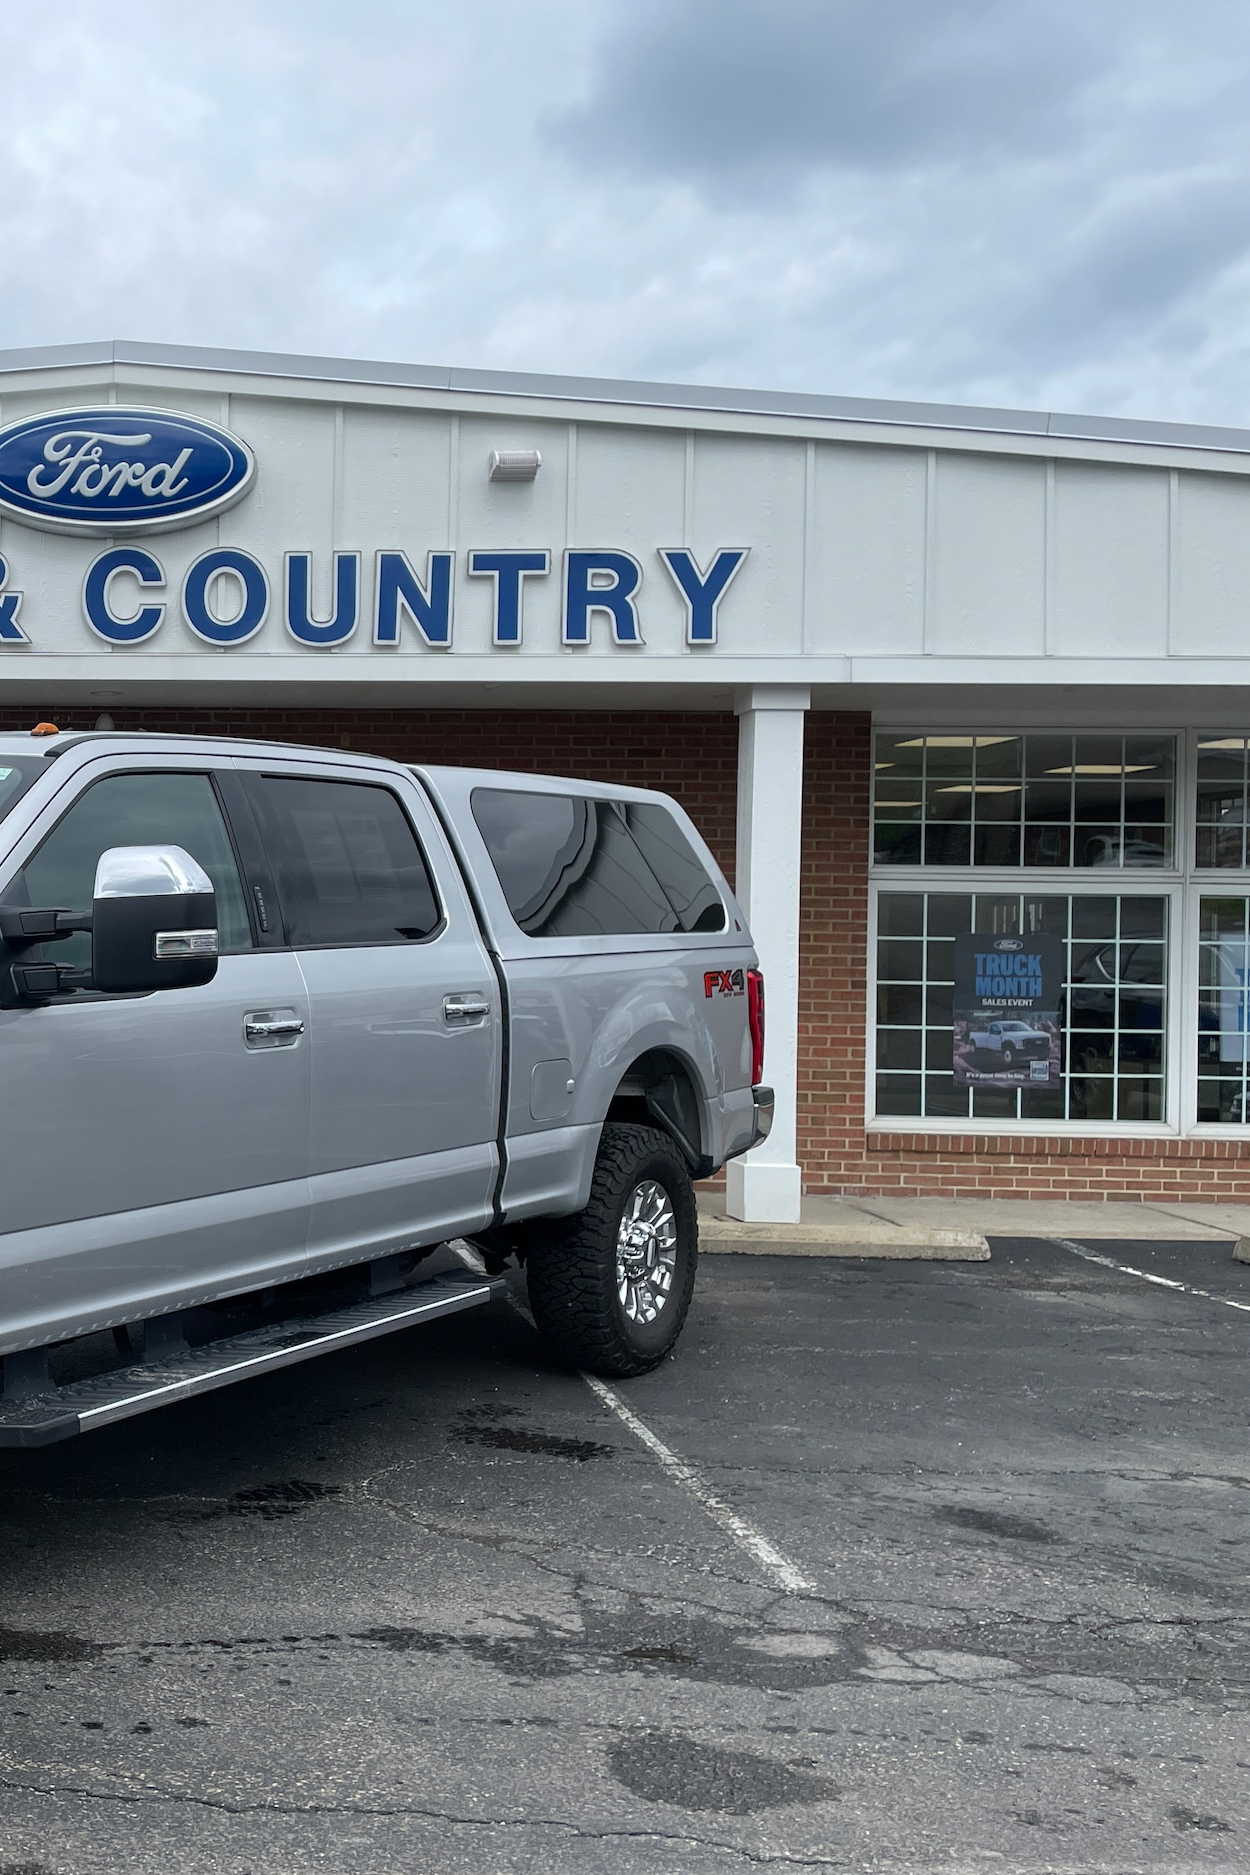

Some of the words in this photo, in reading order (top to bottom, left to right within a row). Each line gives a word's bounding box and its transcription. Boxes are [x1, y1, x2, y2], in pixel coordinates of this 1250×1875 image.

[27, 430, 195, 498] Ford
[84, 544, 751, 648] COUNTRY
[974, 953, 1042, 976] TRUCK
[704, 968, 745, 998] FX4
[975, 976, 1042, 997] MONTH
[982, 998, 1007, 1007] SALES
[1008, 999, 1034, 1007] EVENT
